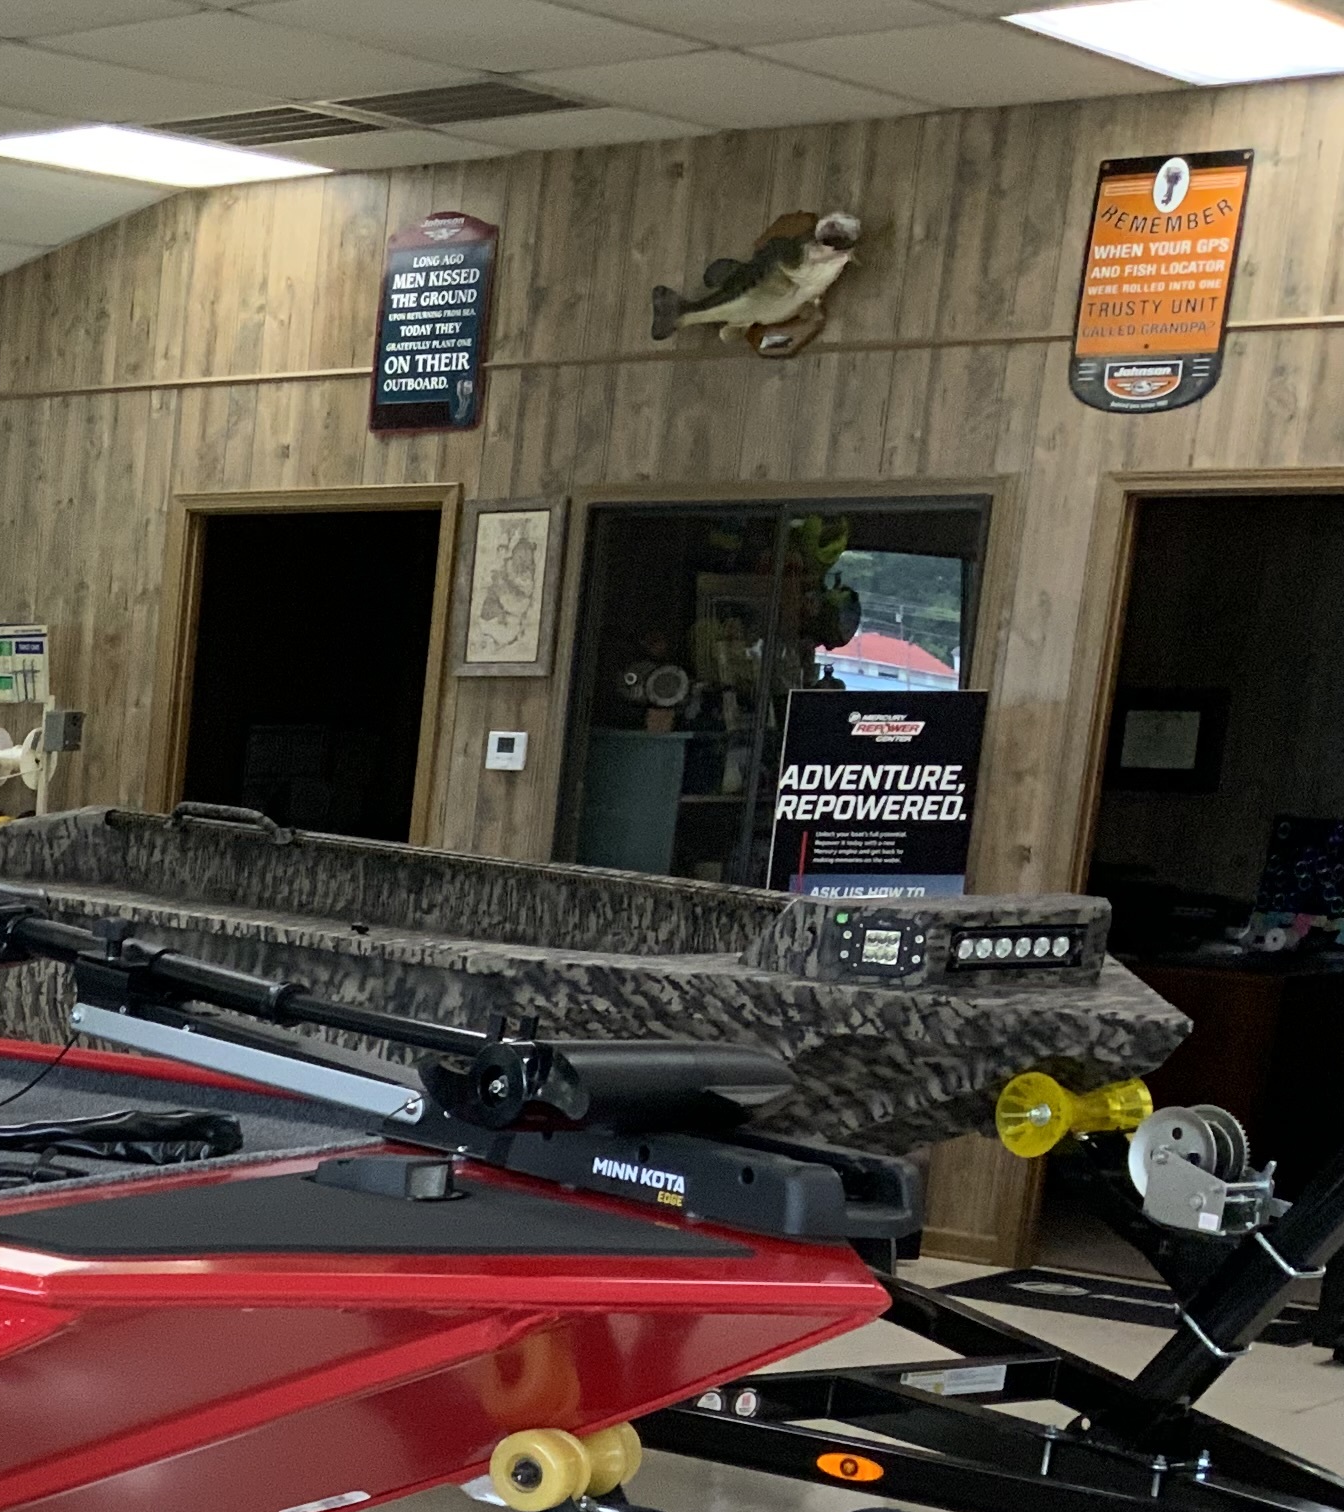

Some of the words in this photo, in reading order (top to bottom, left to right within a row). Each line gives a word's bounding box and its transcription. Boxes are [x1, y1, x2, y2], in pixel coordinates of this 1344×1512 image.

[421, 218, 465, 228] Johnson
[1101, 198, 1234, 234] REMEMBER
[1094, 243, 1143, 259] WHEN
[1149, 239, 1191, 256] YOUR
[1196, 237, 1230, 254] GPS
[413, 255, 440, 268] LONG
[440, 254, 464, 265] AGO
[1091, 266, 1120, 279] AND
[1124, 262, 1156, 276] FISH
[1161, 260, 1225, 274] LOCATOR
[392, 272, 426, 289] MEN
[429, 268, 480, 287] KISSED
[1087, 284, 1119, 295] WERE
[1122, 281, 1165, 294] ROLLED
[1168, 280, 1195, 291] INTO
[1199, 278, 1222, 290] ONE
[391, 293, 418, 308] THE
[420, 289, 477, 306] GROUND
[1087, 299, 1162, 317] TRUSTY
[1171, 296, 1218, 314] UNIT
[389, 312, 406, 321] UPON
[407, 310, 442, 320] RETURNING
[443, 309, 461, 317] FROM
[400, 324, 433, 337] TODAY
[435, 322, 462, 334] THEY
[1082, 325, 1136, 338] CALLED
[1141, 320, 1216, 335] GRANDPA?
[386, 341, 430, 351] GRATEFULLY
[432, 340, 456, 349] PLANT
[457, 338, 472, 347] ONE
[384, 356, 411, 374] ON
[415, 352, 470, 372] THEIR
[1114, 366, 1172, 377] Johnson
[383, 377, 449, 391] OUTBOARD.
[856, 723, 920, 733] REPOWER
[779, 765, 966, 794] ADVENTURE,
[776, 795, 967, 821] REPOWERED.
[810, 887, 841, 898] ASK
[844, 887, 864, 897] US
[867, 887, 904, 898] HOW
[592, 1157, 639, 1183] MINN
[640, 1167, 685, 1194] KOTA
[657, 1190, 684, 1207] EDGE
